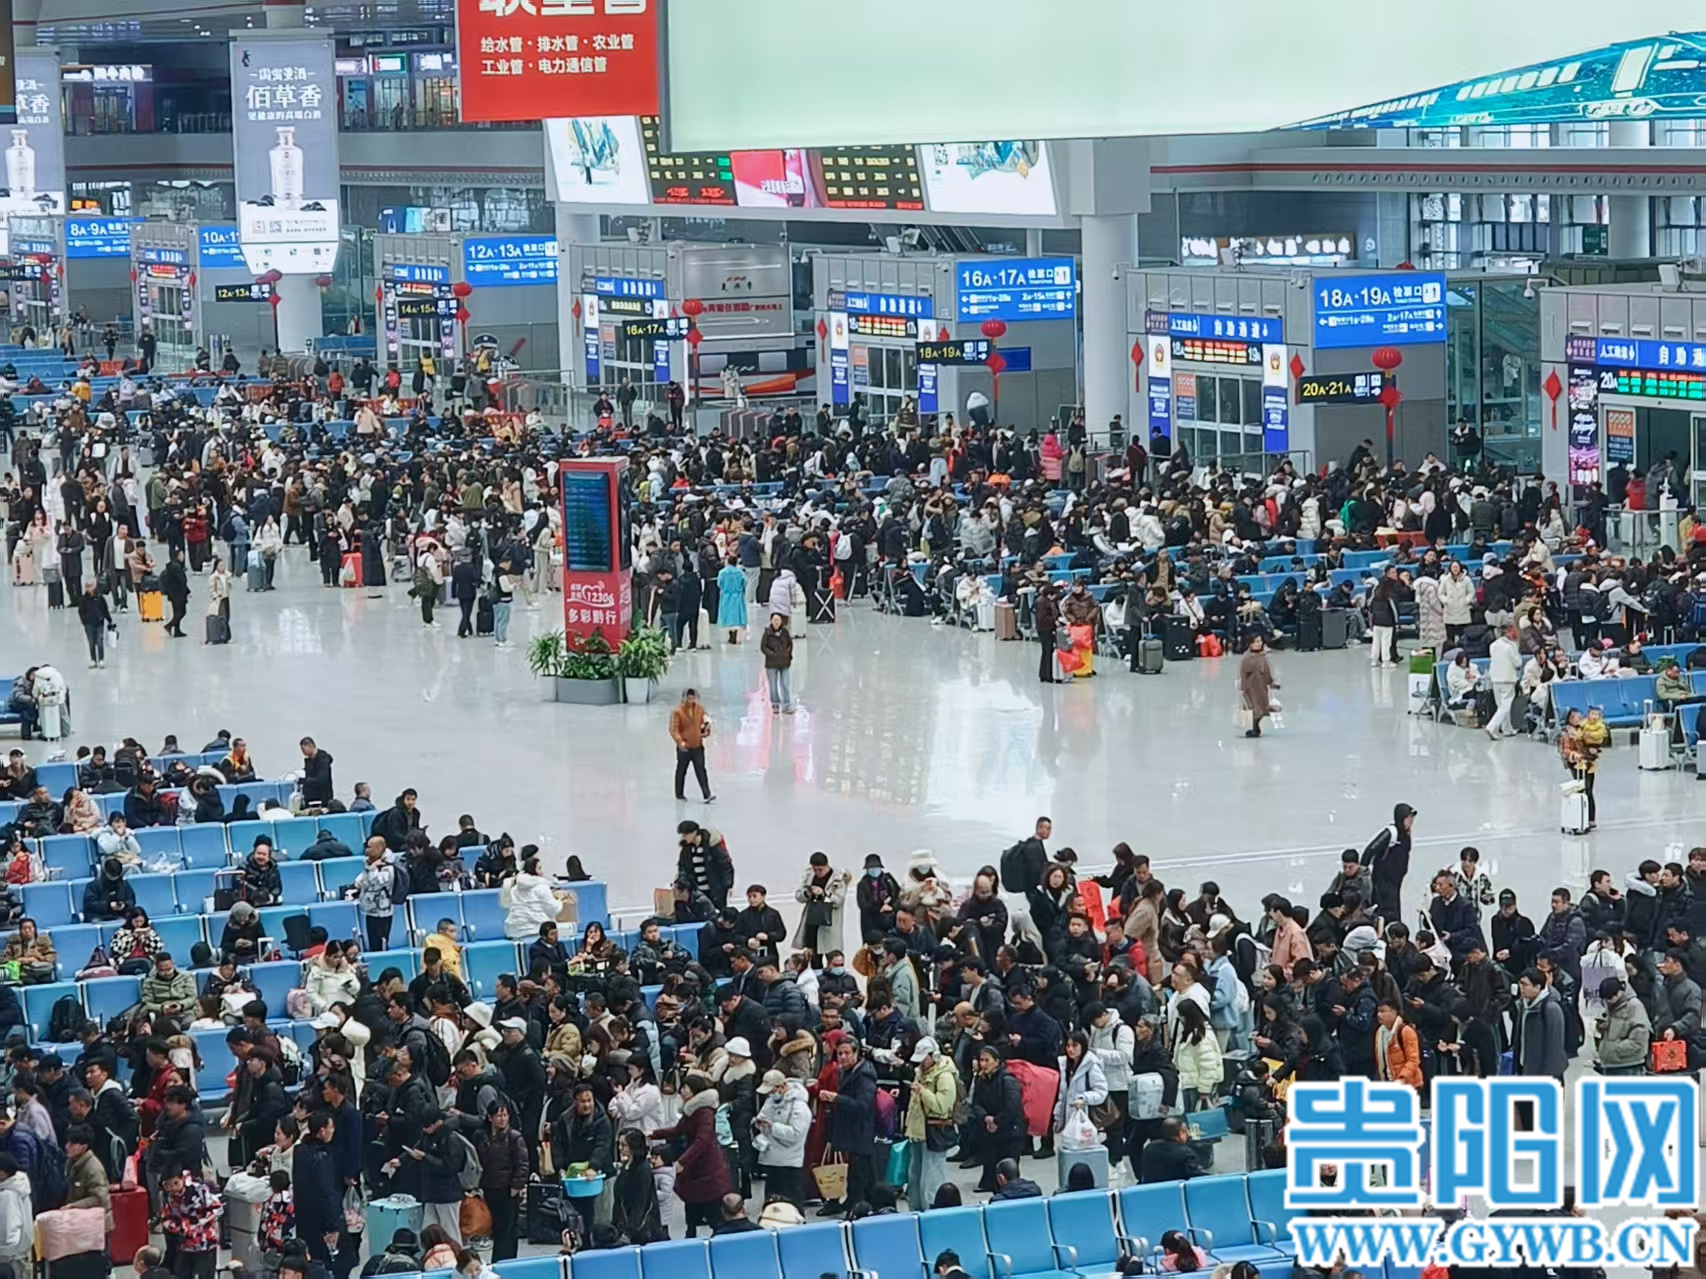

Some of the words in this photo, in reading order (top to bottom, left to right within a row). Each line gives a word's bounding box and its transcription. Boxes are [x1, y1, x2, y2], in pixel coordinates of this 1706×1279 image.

[480, 34, 634, 53] 给水管·排水管·农业管
[481, 57, 607, 75] 工业管·电力通信管
[246, 84, 322, 109] 佰草香
[203, 231, 239, 243] 10A·1
[469, 244, 522, 258] 12A·13A
[962, 269, 1026, 287] 16A·17A
[218, 288, 249, 298] 12A·13A
[1320, 287, 1391, 307] 18A·19A
[402, 304, 436, 315] 14A·15A
[626, 324, 664, 336] 16A·17A
[1214, 318, 1260, 339] 自助通道
[919, 346, 962, 359] 18A·19A
[1302, 381, 1353, 397] 20A·21A
[587, 591, 615, 604] 12306
[568, 608, 617, 625] 多彩黔行
